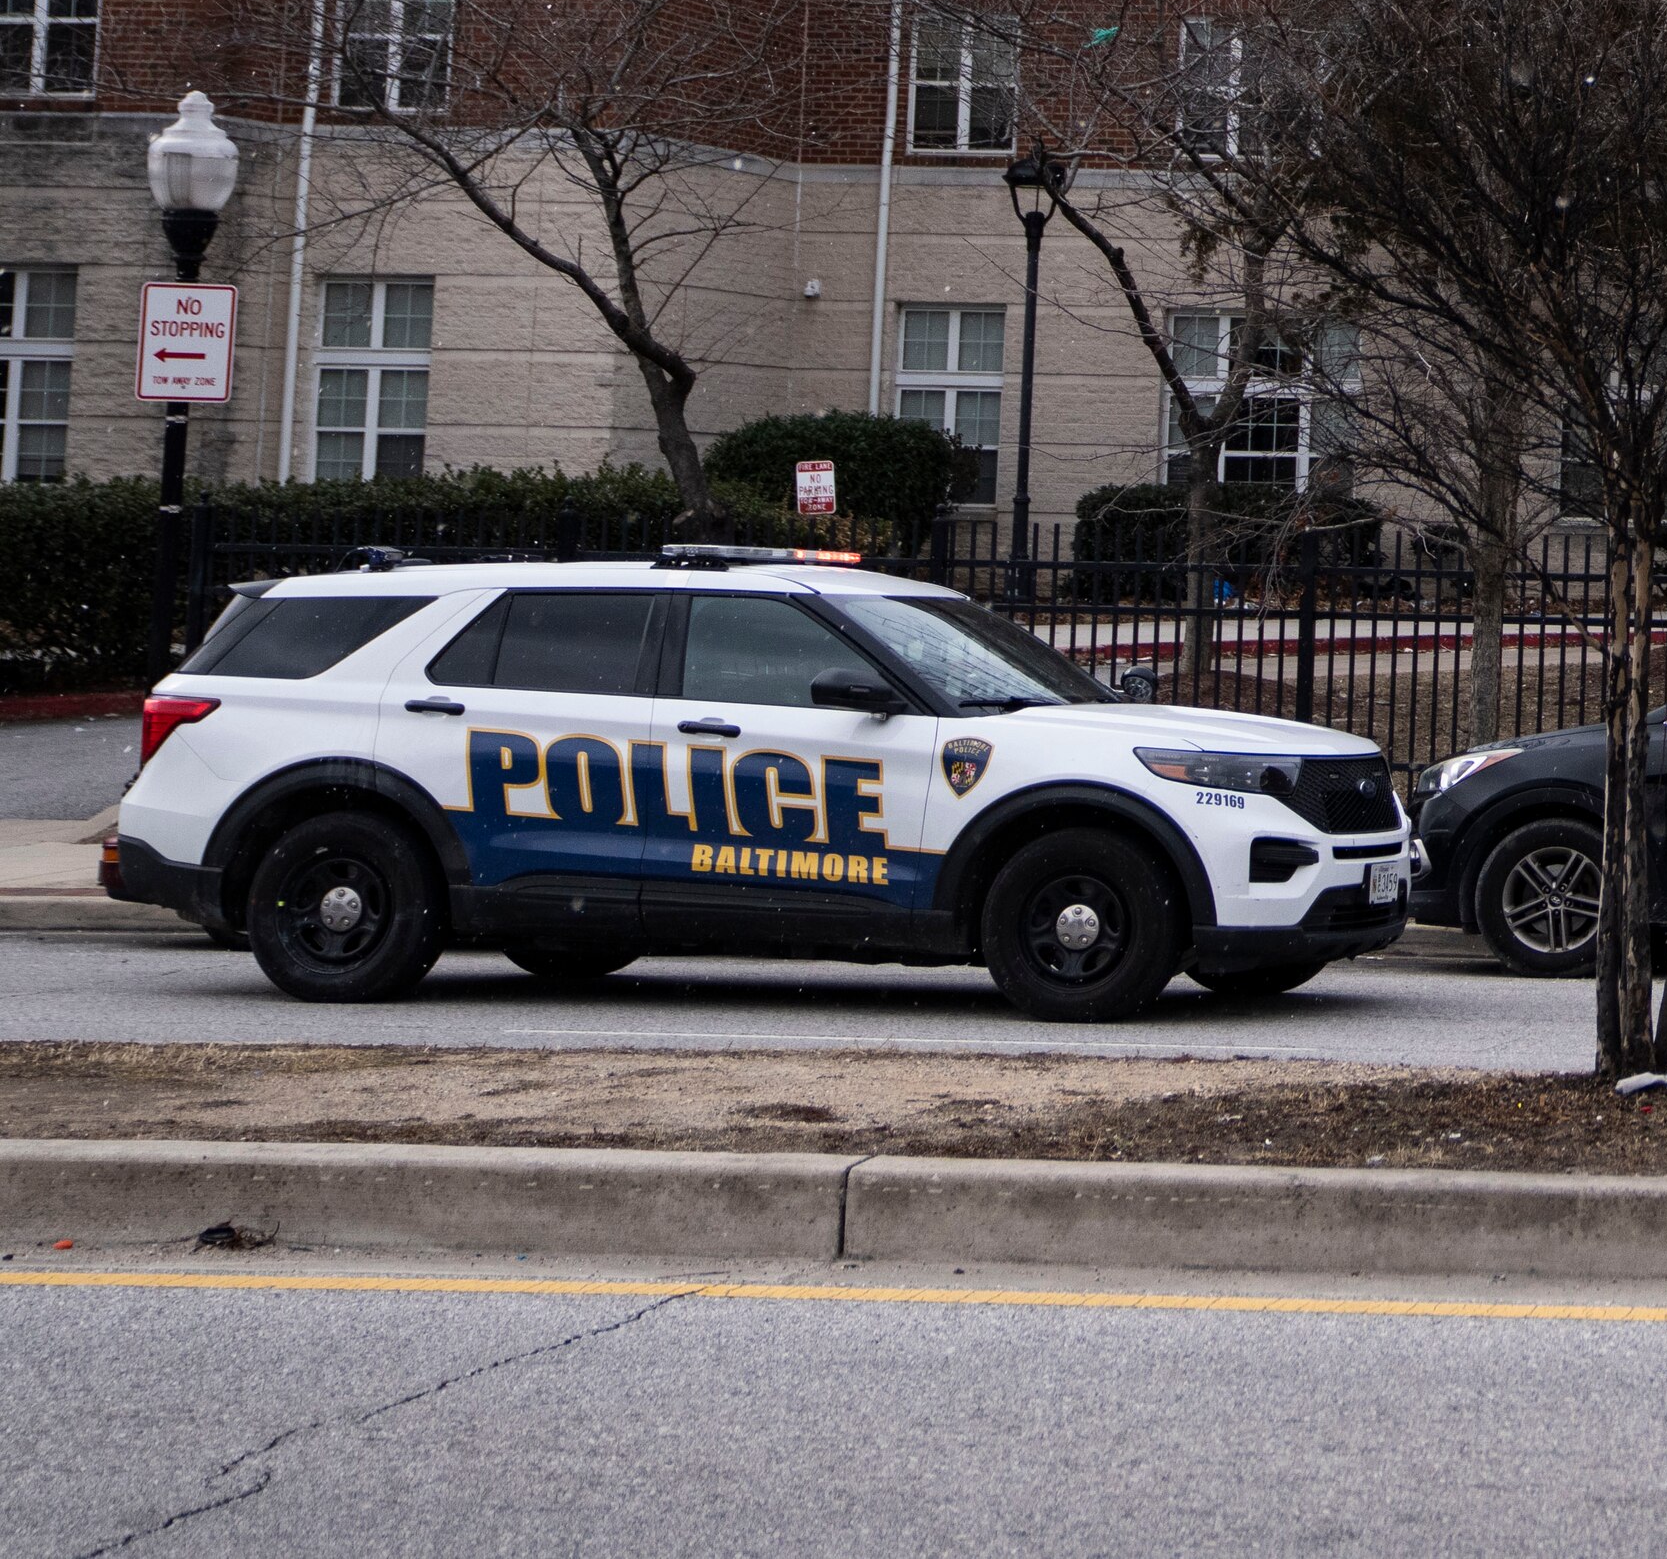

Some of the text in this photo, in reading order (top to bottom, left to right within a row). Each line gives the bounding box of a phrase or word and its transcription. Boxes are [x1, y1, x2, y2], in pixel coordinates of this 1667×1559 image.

[176, 299, 202, 315] NO
[150, 320, 225, 339] STOPPING
[152, 375, 169, 385] TOW
[194, 377, 216, 387] ZONE
[815, 462, 832, 470] LANE
[810, 473, 822, 483] NO
[799, 485, 834, 496] PARKING
[947, 740, 990, 752] BALTIMORE
[954, 746, 981, 756] POLICE
[466, 727, 890, 844] POLICE
[1196, 791, 1245, 809] 229169
[691, 843, 889, 886] BALTIMORE
